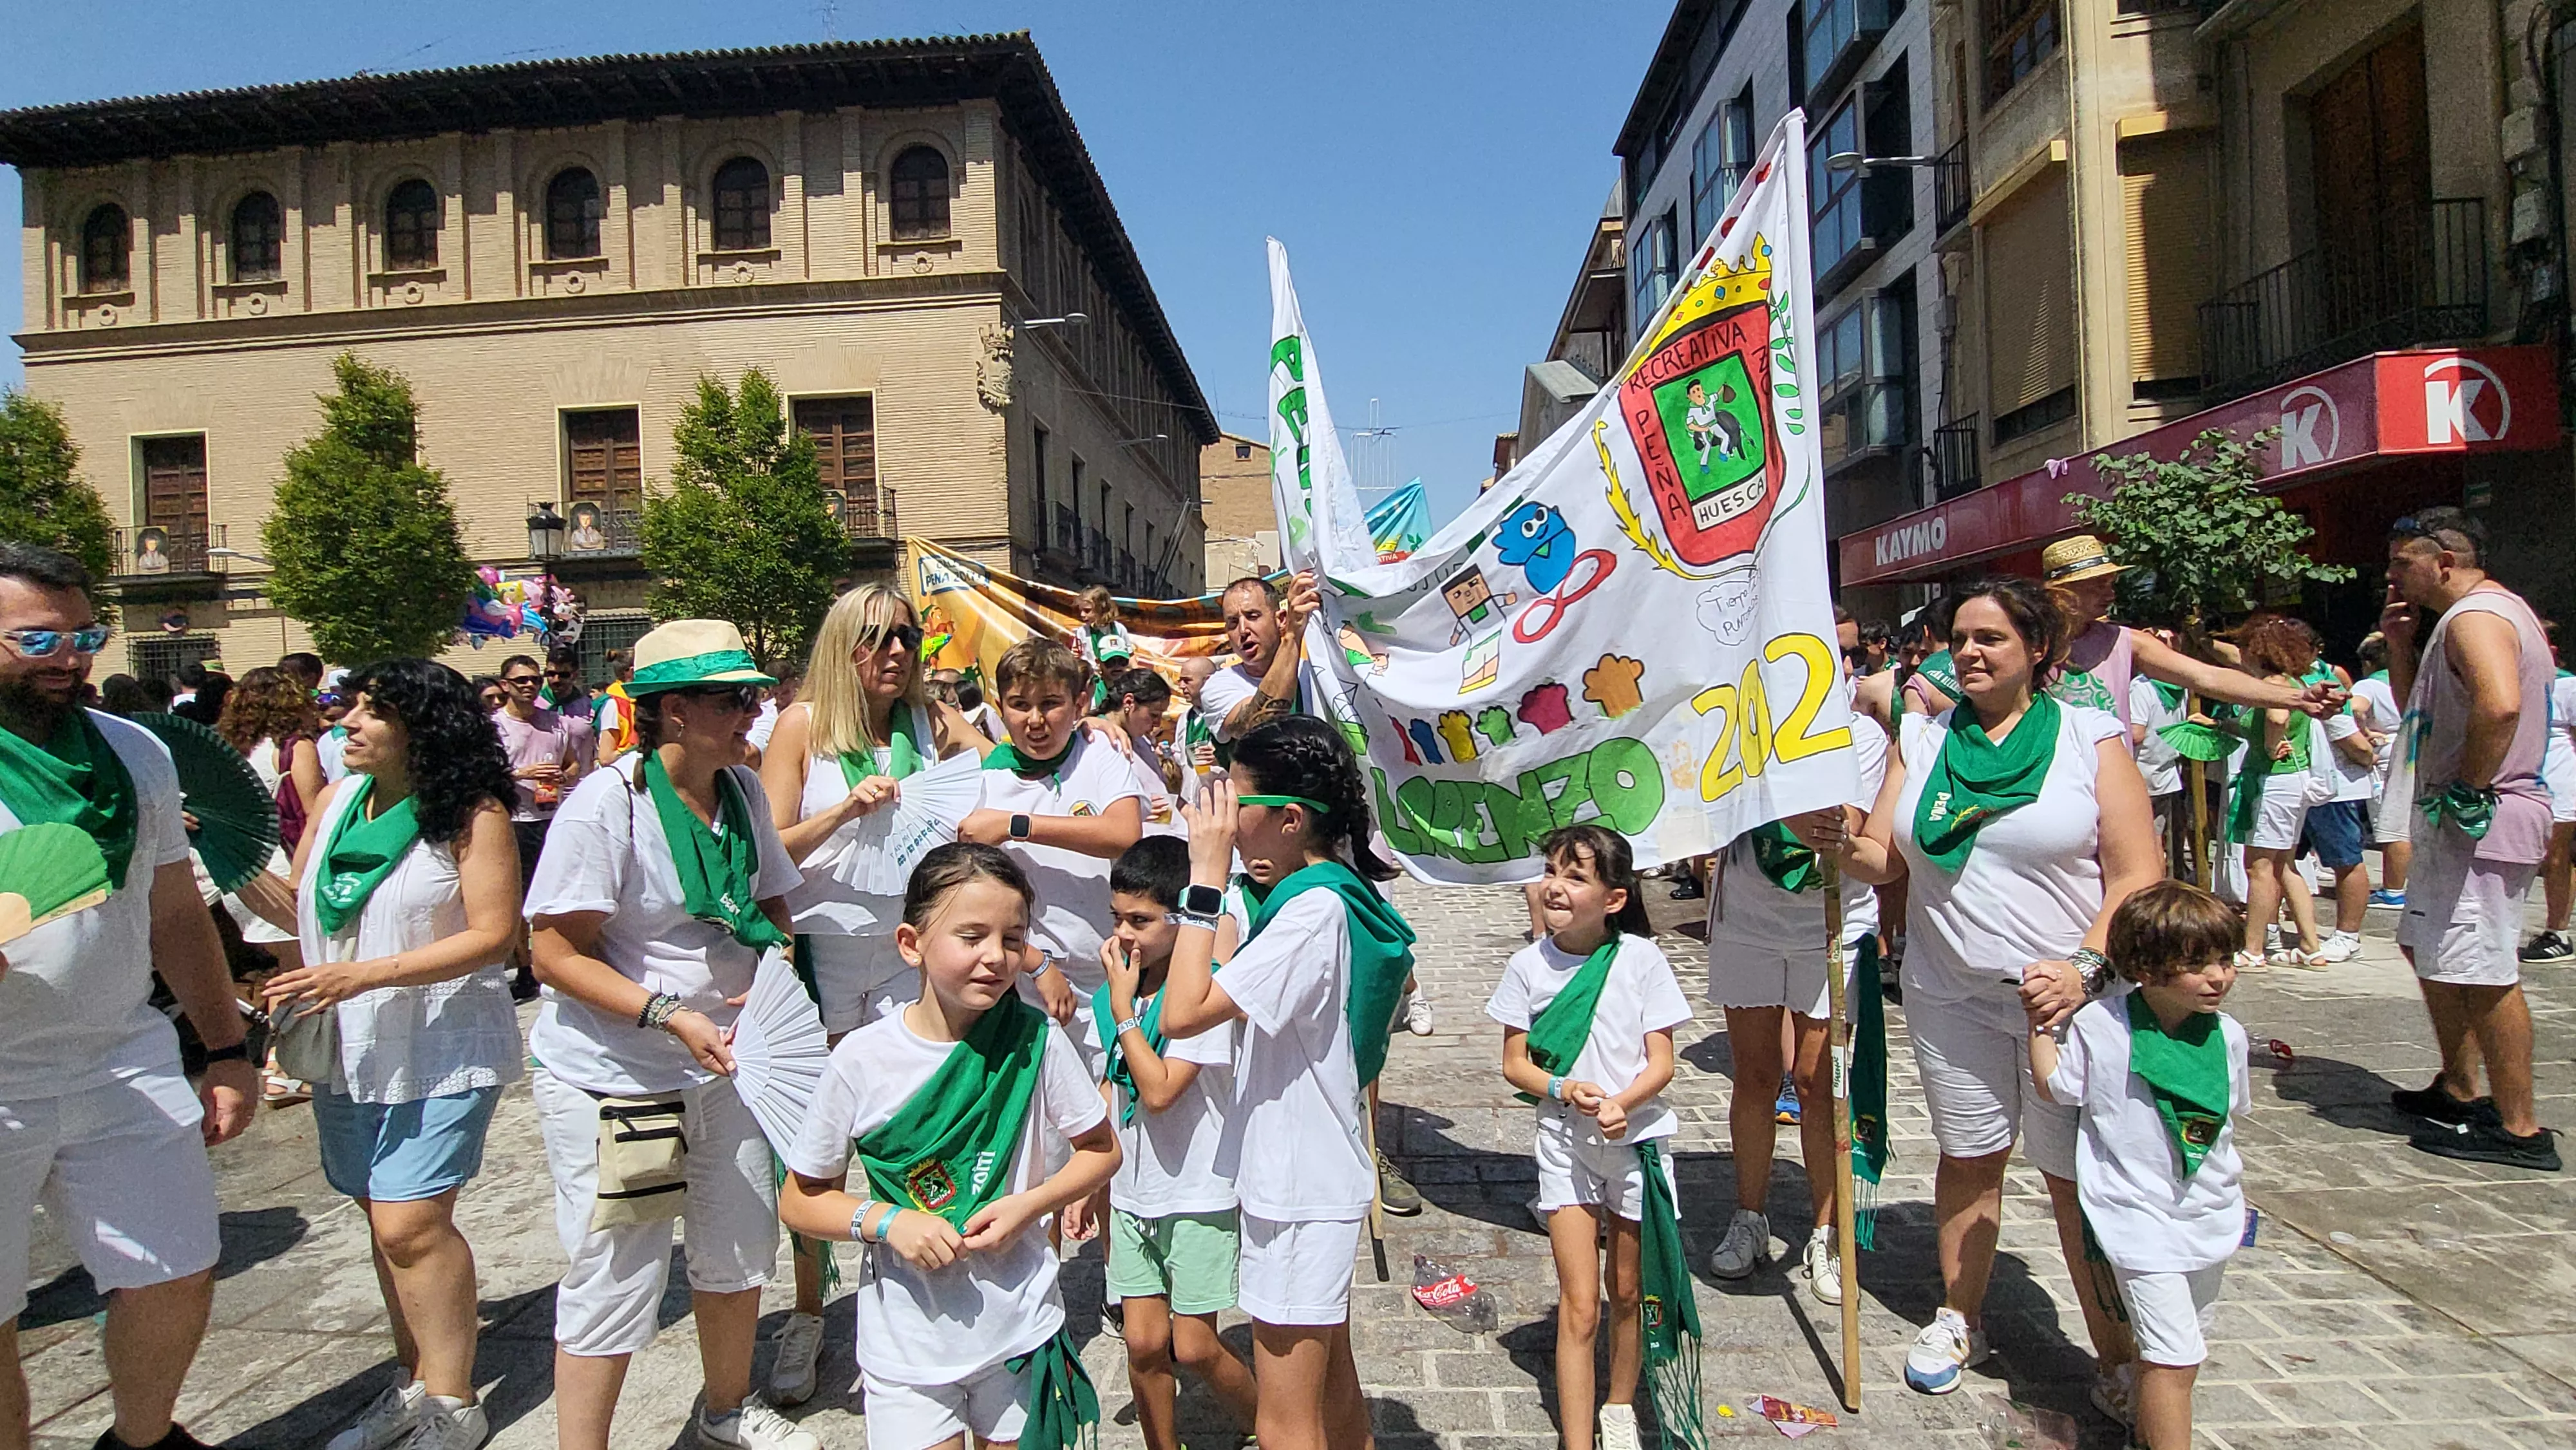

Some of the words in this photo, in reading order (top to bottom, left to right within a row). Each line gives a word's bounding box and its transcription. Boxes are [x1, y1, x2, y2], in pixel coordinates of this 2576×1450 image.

[1629, 322, 1747, 395] RECREATIVA
[1636, 410, 1687, 521] PEÑA
[1698, 476, 1765, 523] HUESCA
[1875, 517, 1946, 567] KAYMO
[1929, 791, 1951, 821] PEÑA
